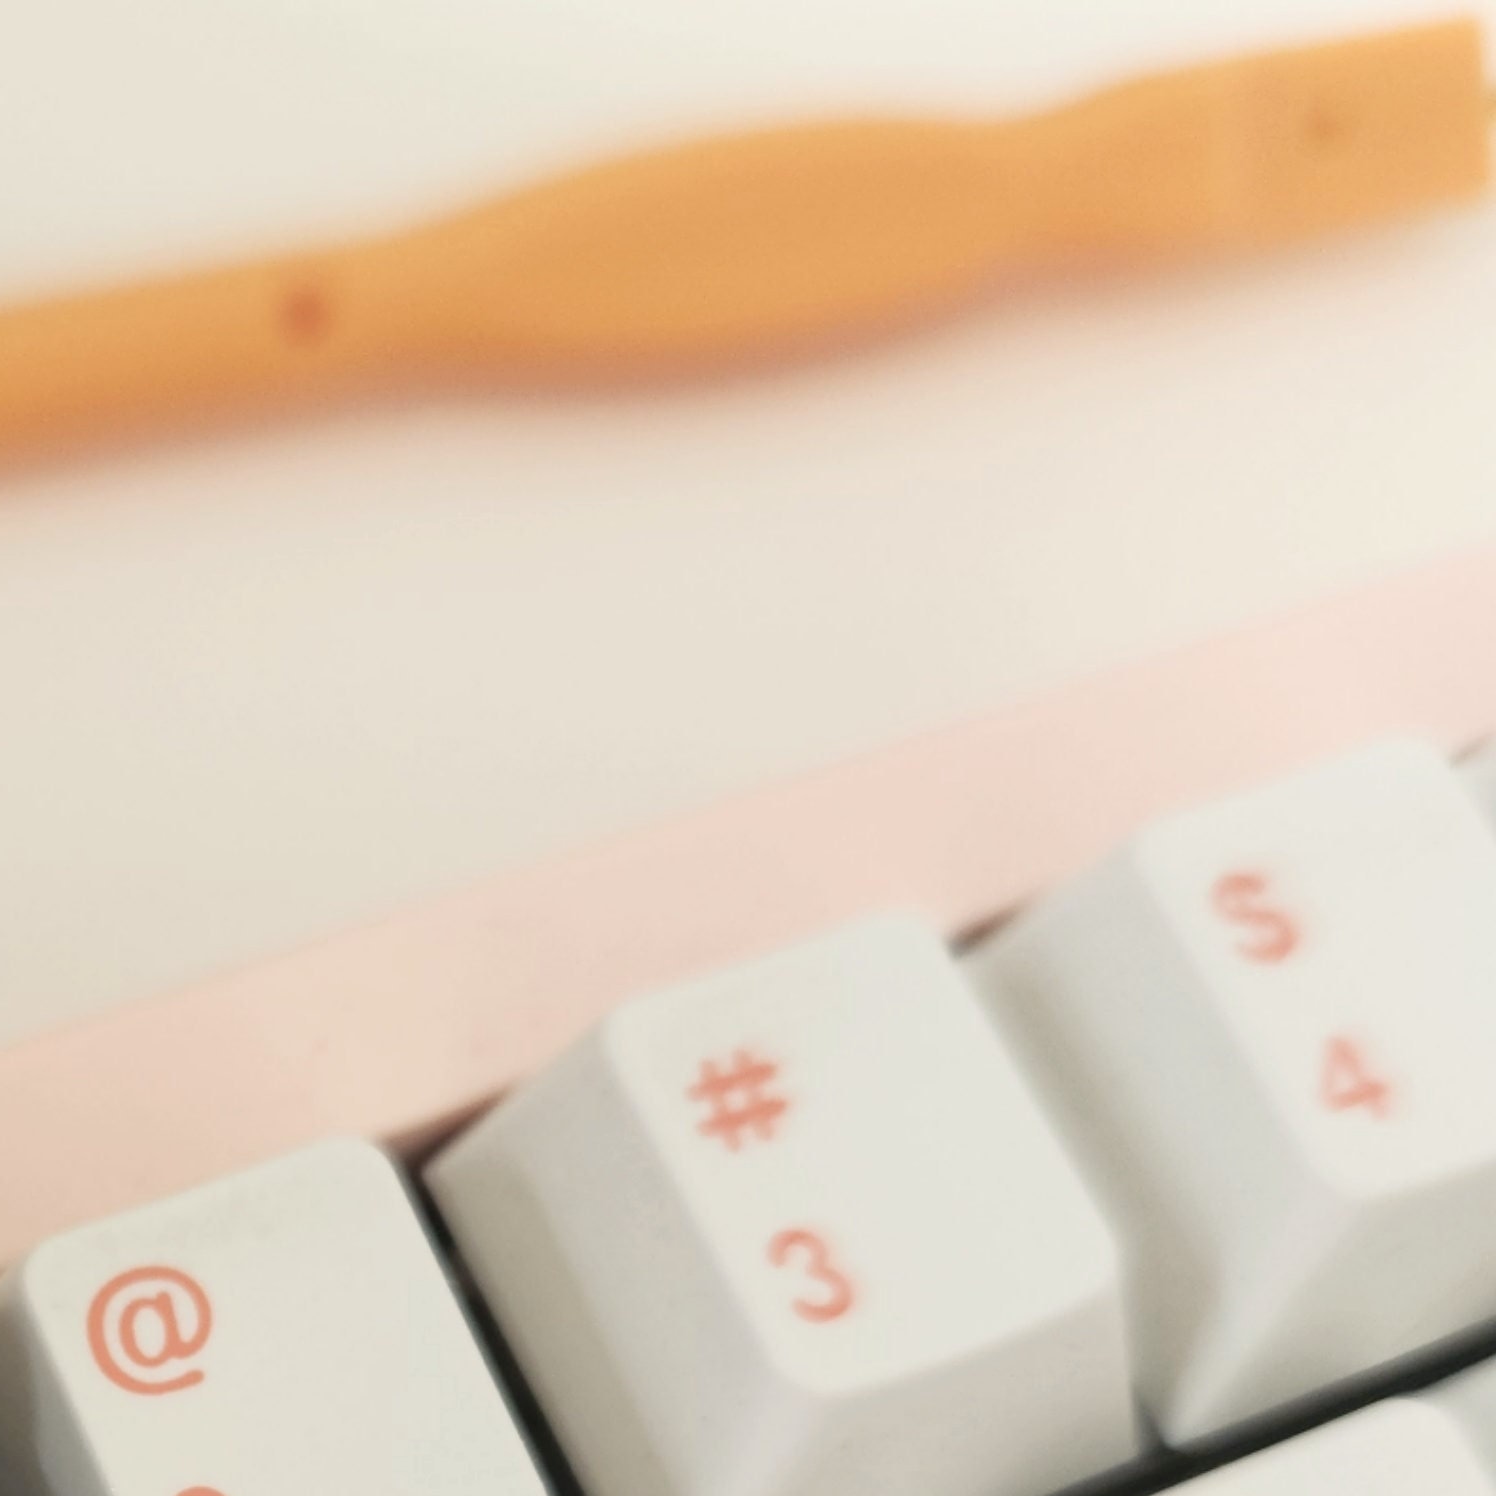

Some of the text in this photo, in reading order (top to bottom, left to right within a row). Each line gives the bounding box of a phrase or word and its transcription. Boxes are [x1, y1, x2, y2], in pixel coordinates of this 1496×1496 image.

[691, 1050, 789, 1148] #
[1319, 1033, 1395, 1121] 4
[769, 1227, 856, 1324] 3
[87, 1266, 212, 1396] @
